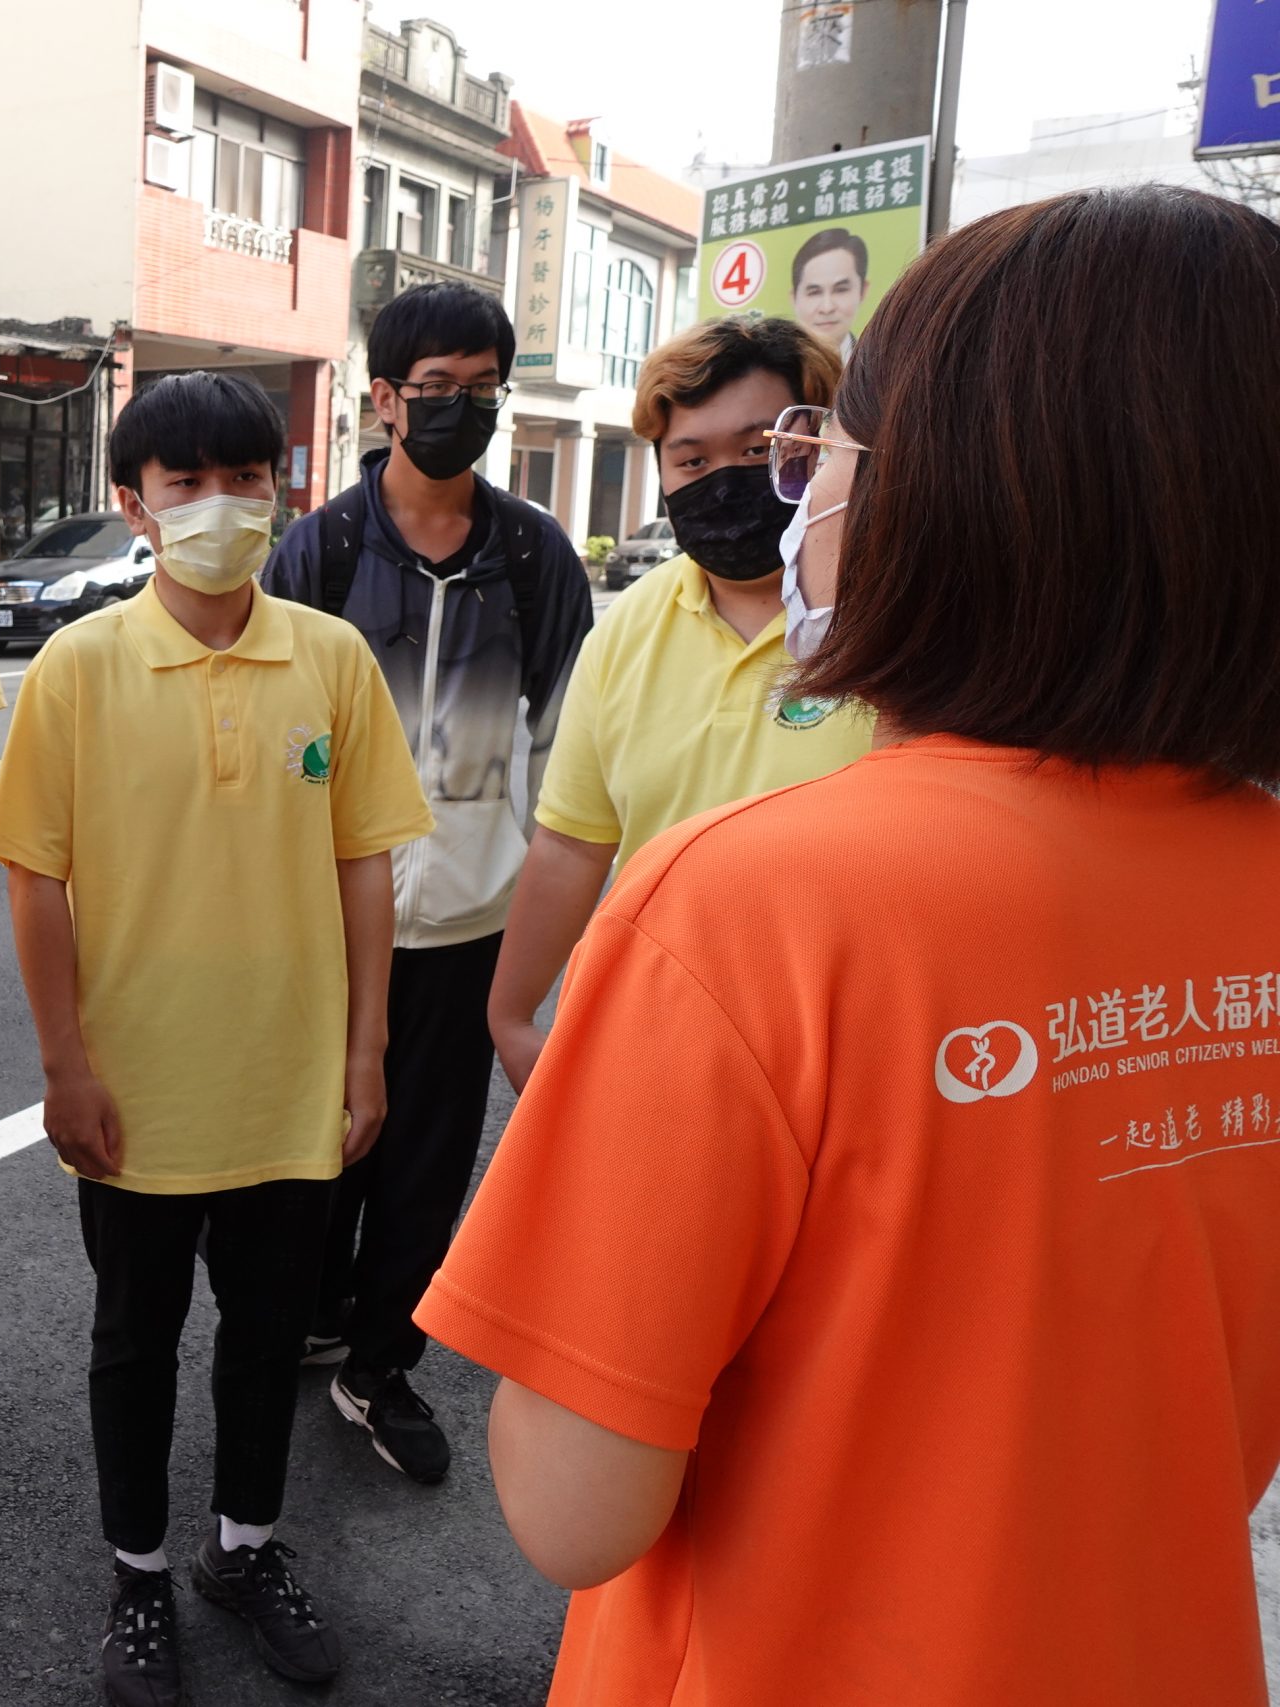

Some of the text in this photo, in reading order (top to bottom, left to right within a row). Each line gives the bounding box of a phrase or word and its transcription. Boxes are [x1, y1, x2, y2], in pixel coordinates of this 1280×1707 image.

[722, 252, 751, 296] 4
[1045, 971, 1280, 1063] 弘道老人福利
[1052, 1039, 1280, 1093] HONDAO SENIOR CITIZEN'S WEL
[1221, 1093, 1280, 1137] 精彩
